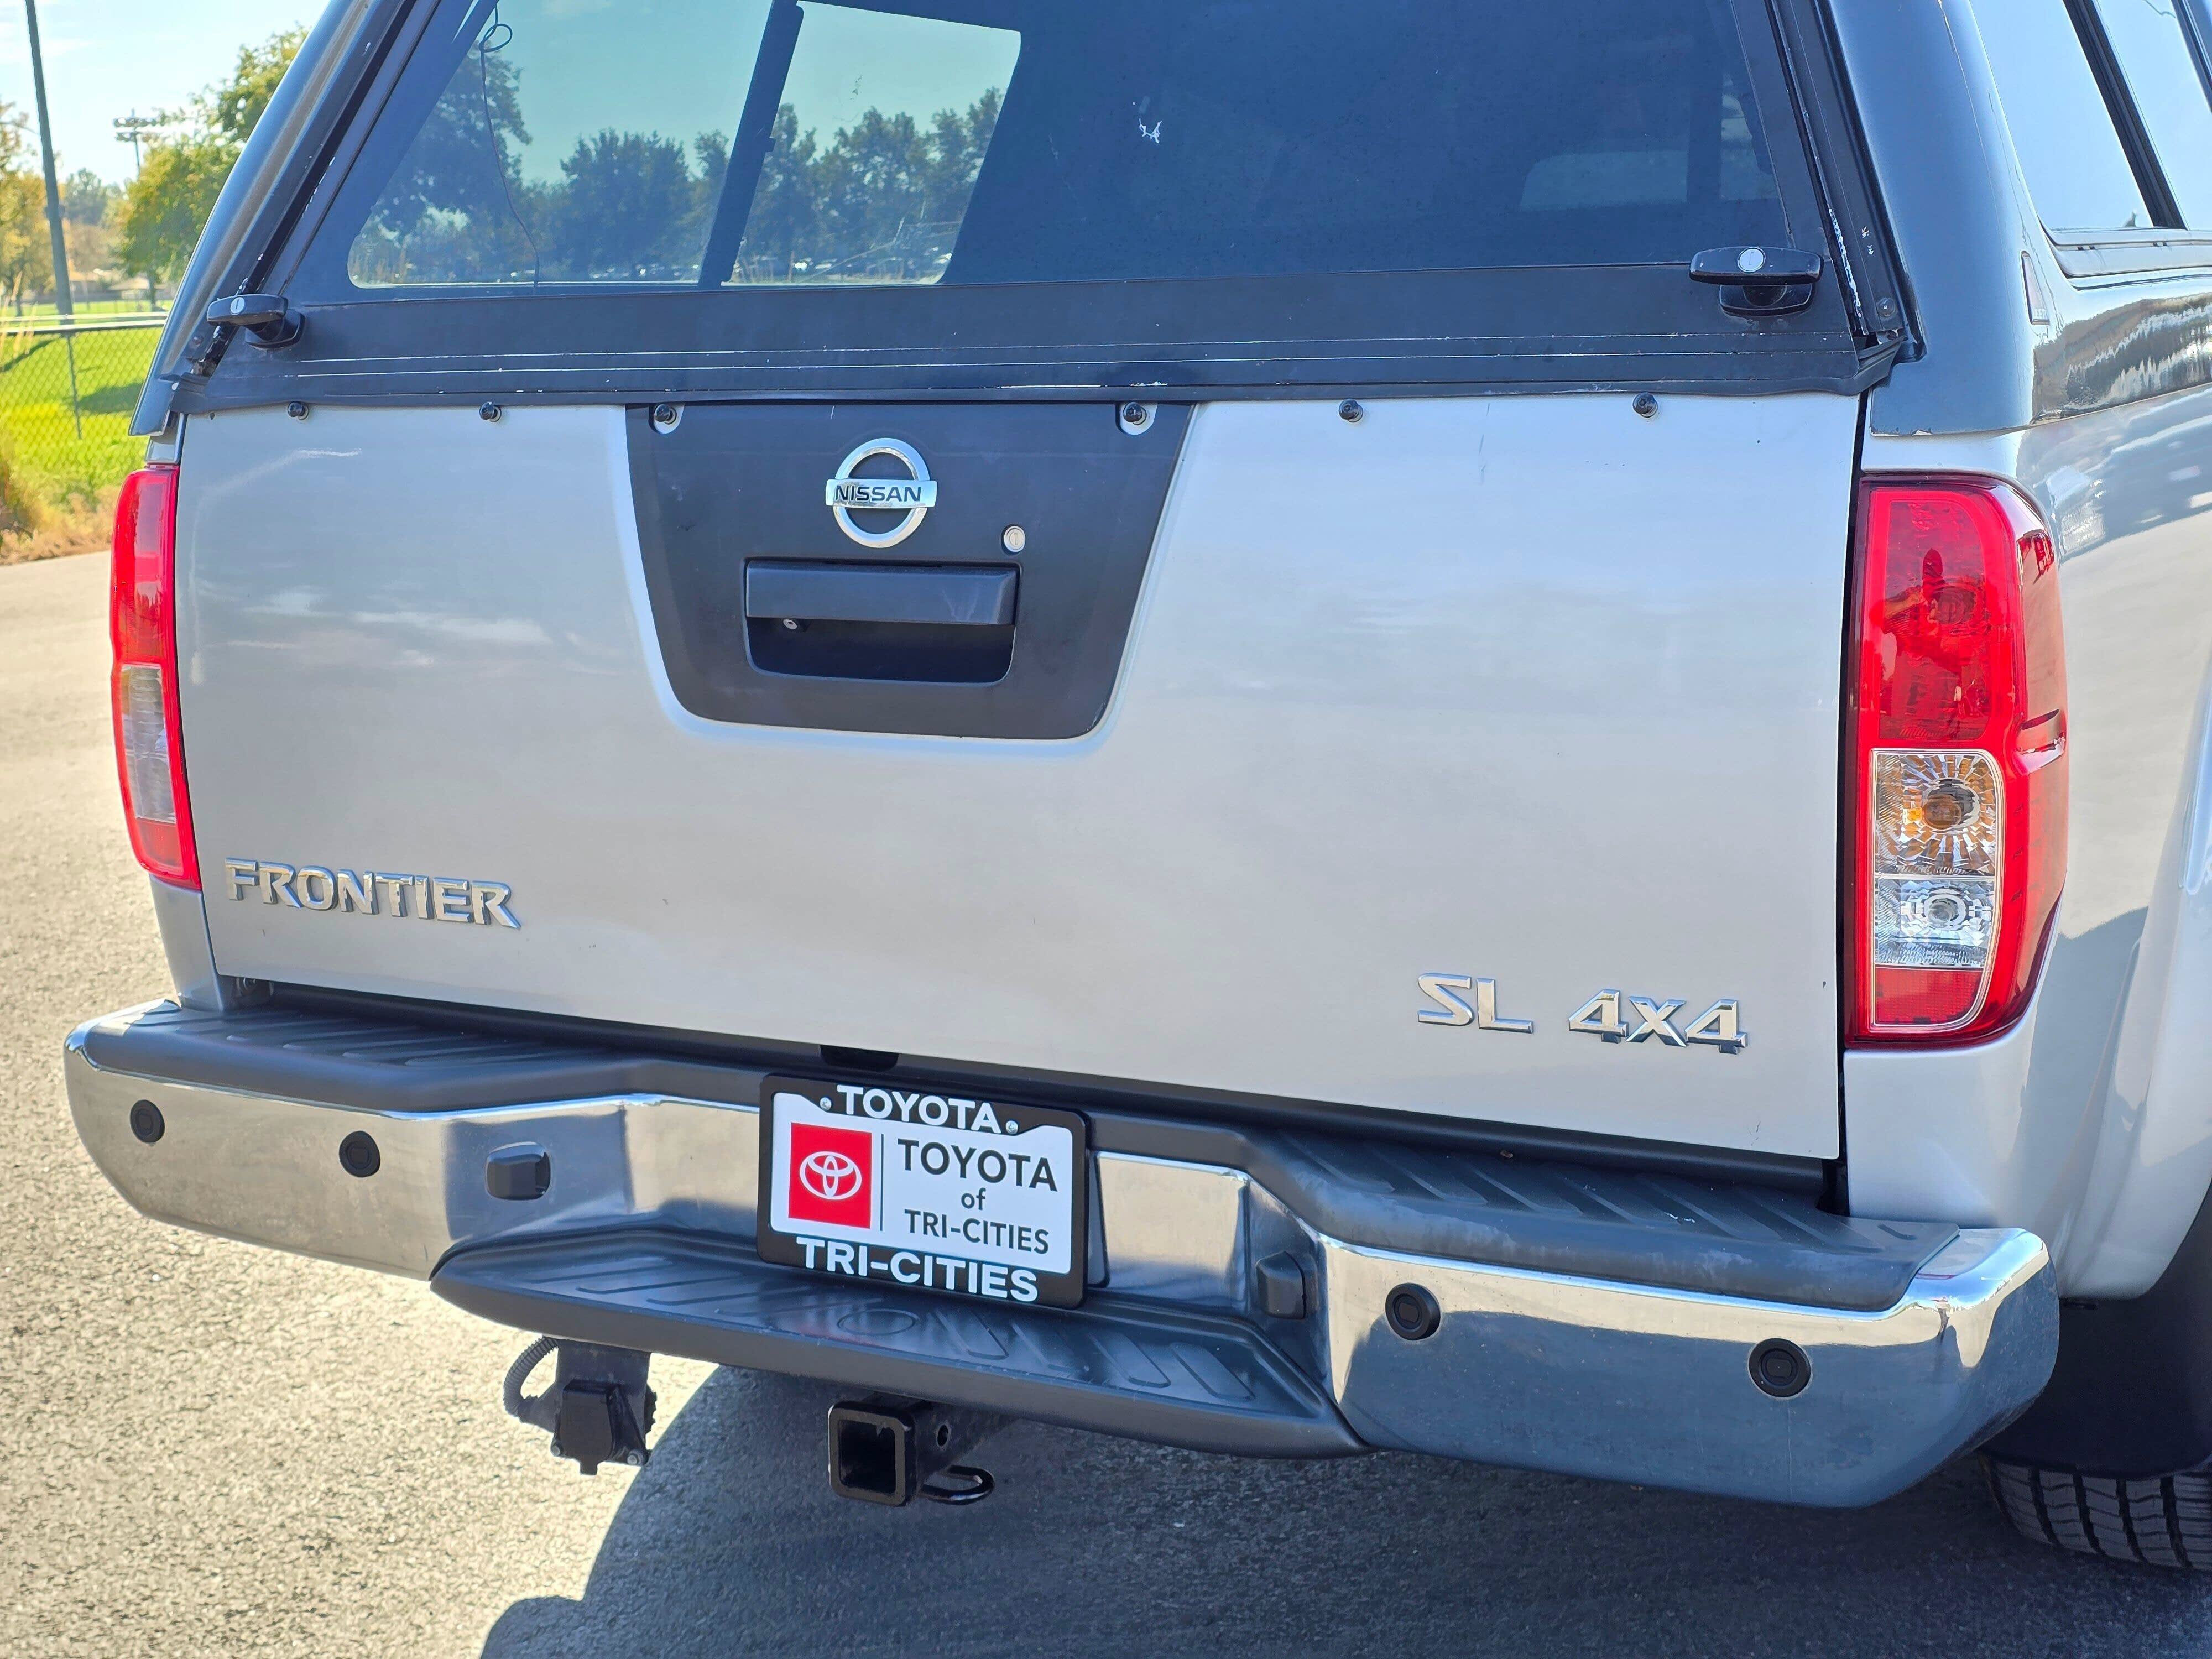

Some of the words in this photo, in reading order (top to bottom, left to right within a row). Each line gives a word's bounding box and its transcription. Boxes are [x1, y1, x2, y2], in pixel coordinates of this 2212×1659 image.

[835, 485, 921, 502] NISSAN
[225, 857, 521, 929] FRONTIER
[1417, 973, 1533, 1034] SL
[837, 1084, 1001, 1134] TOYOTA
[898, 1138, 1057, 1192] TOYOTA
[961, 1188, 986, 1211] of
[904, 1209, 1049, 1254] TRI-CITIES
[796, 1237, 1038, 1302] TRI-CITIES
